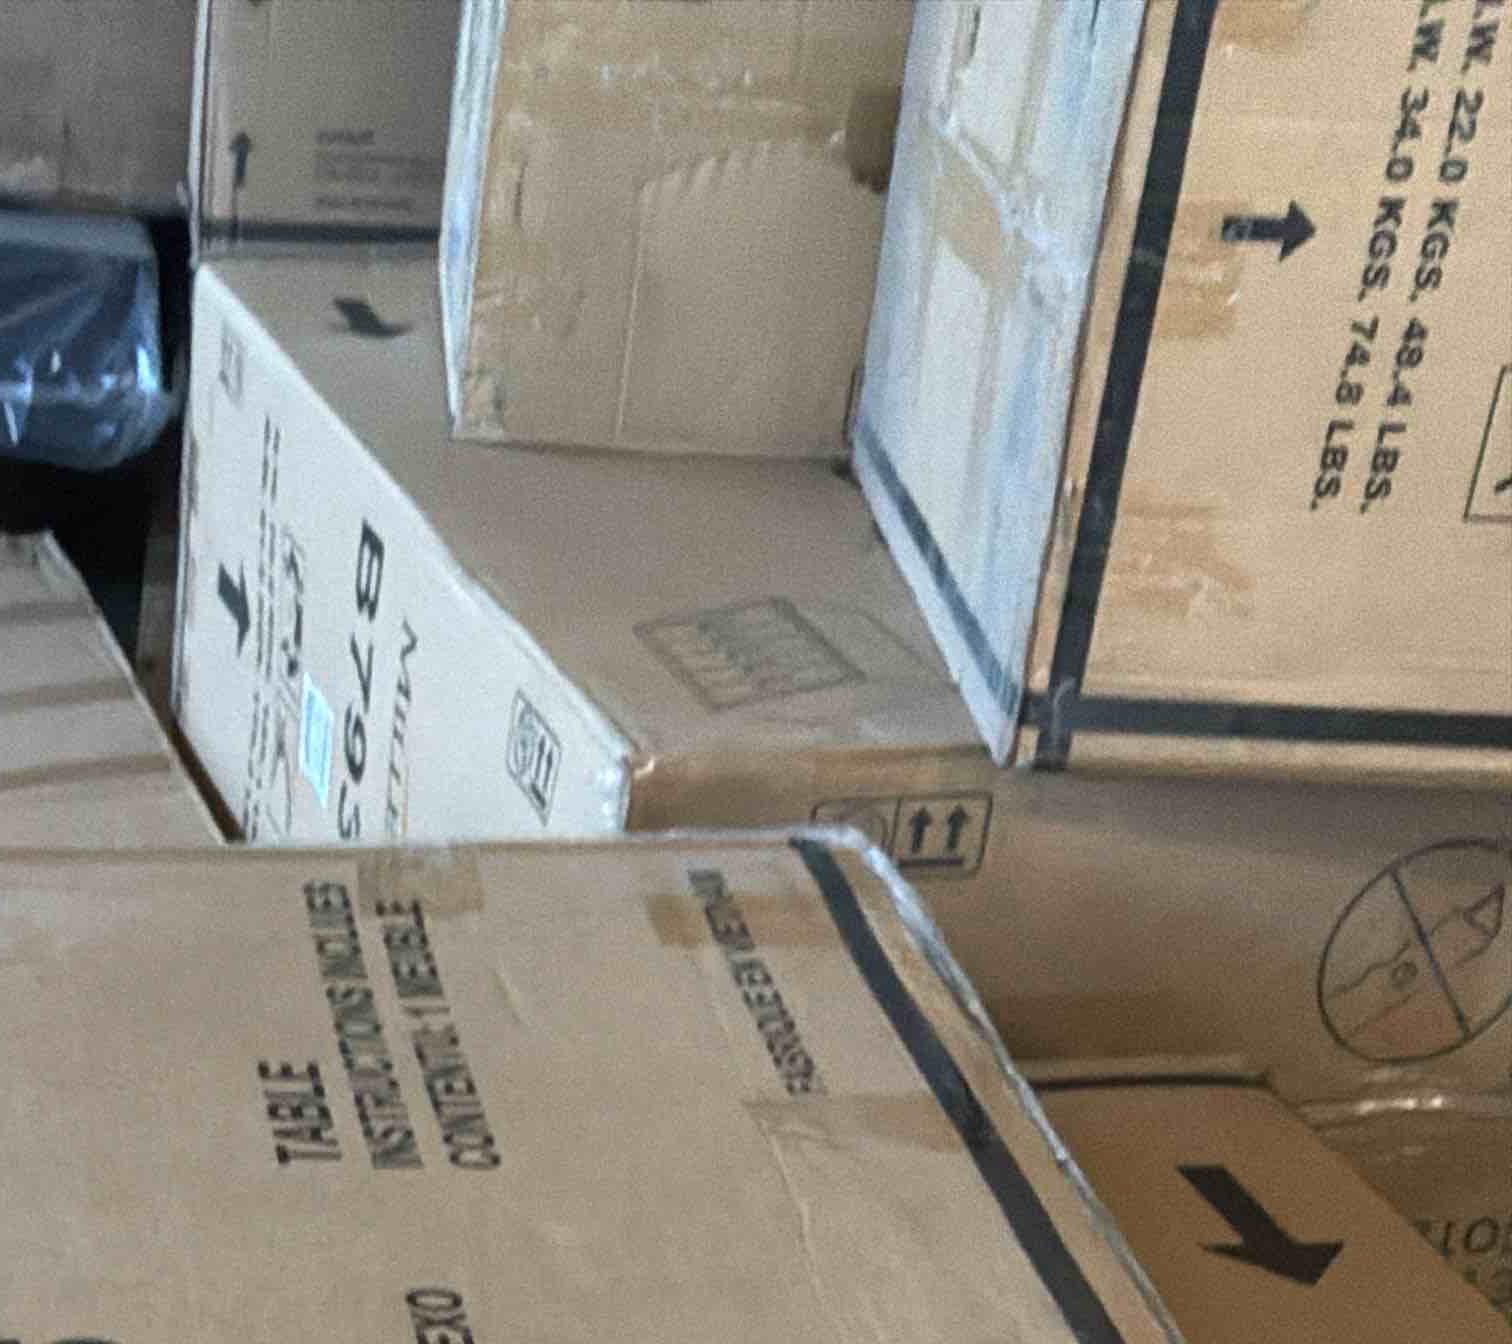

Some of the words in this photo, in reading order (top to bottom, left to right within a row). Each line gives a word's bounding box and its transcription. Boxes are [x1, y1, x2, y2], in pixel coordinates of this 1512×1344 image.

[1384, 86, 1429, 184] 34.0
[1439, 89, 1485, 184] 22.0
[1357, 197, 1406, 303] KGS.
[1411, 198, 1460, 303] KGS.
[1333, 315, 1379, 407] 74.8
[1387, 318, 1428, 408] 48.4
[1310, 418, 1355, 512] LBS.
[1360, 421, 1406, 514] LBS.
[257, 1059, 342, 1166] TABLE
